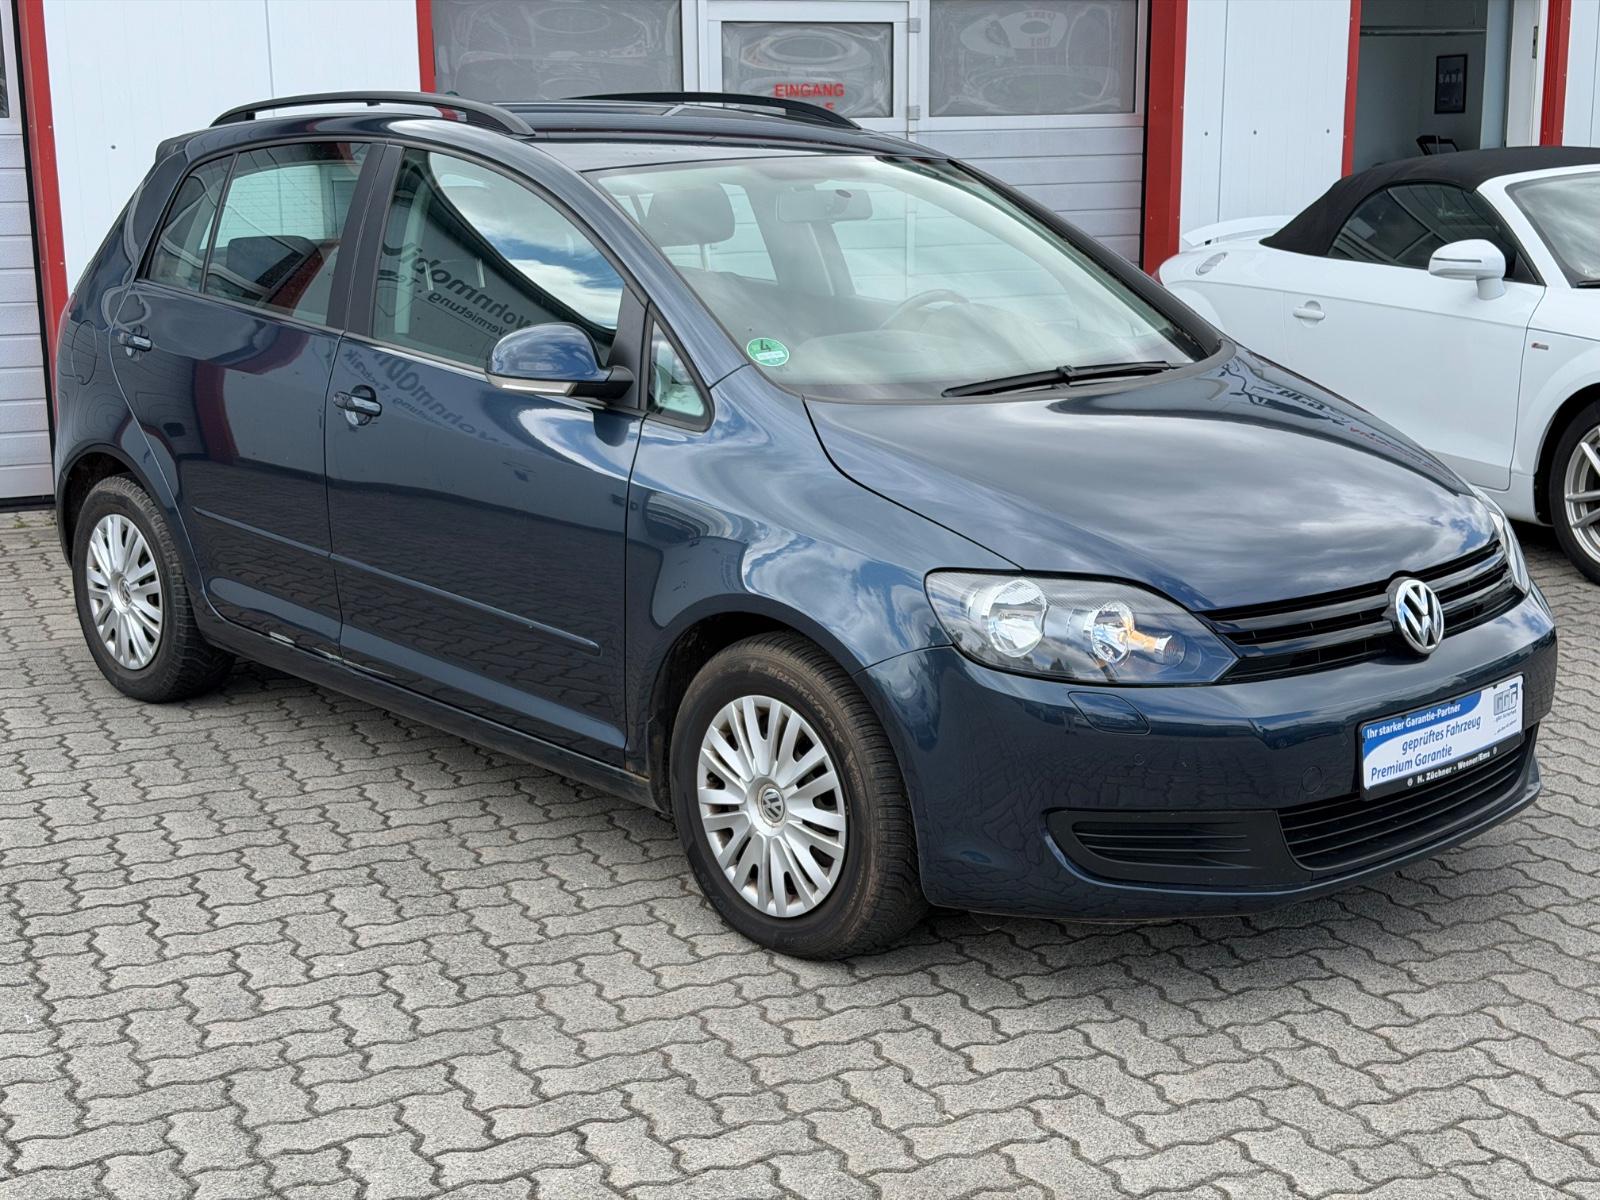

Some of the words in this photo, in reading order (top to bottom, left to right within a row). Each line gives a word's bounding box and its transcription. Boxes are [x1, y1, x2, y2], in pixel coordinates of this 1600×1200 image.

[774, 83, 845, 97] EINGANG
[1397, 580, 1443, 653] VW
[1366, 728, 1378, 739] Ihr
[1379, 721, 1405, 736] starker
[1405, 703, 1461, 728] Garantie-Partner
[1401, 730, 1444, 755] geprüftes
[1445, 715, 1482, 738] Fahrzeug
[1371, 759, 1413, 781] Premium
[1414, 744, 1453, 767] Garantie
[1417, 775, 1425, 784] H.
[1426, 766, 1452, 781] Züchner
